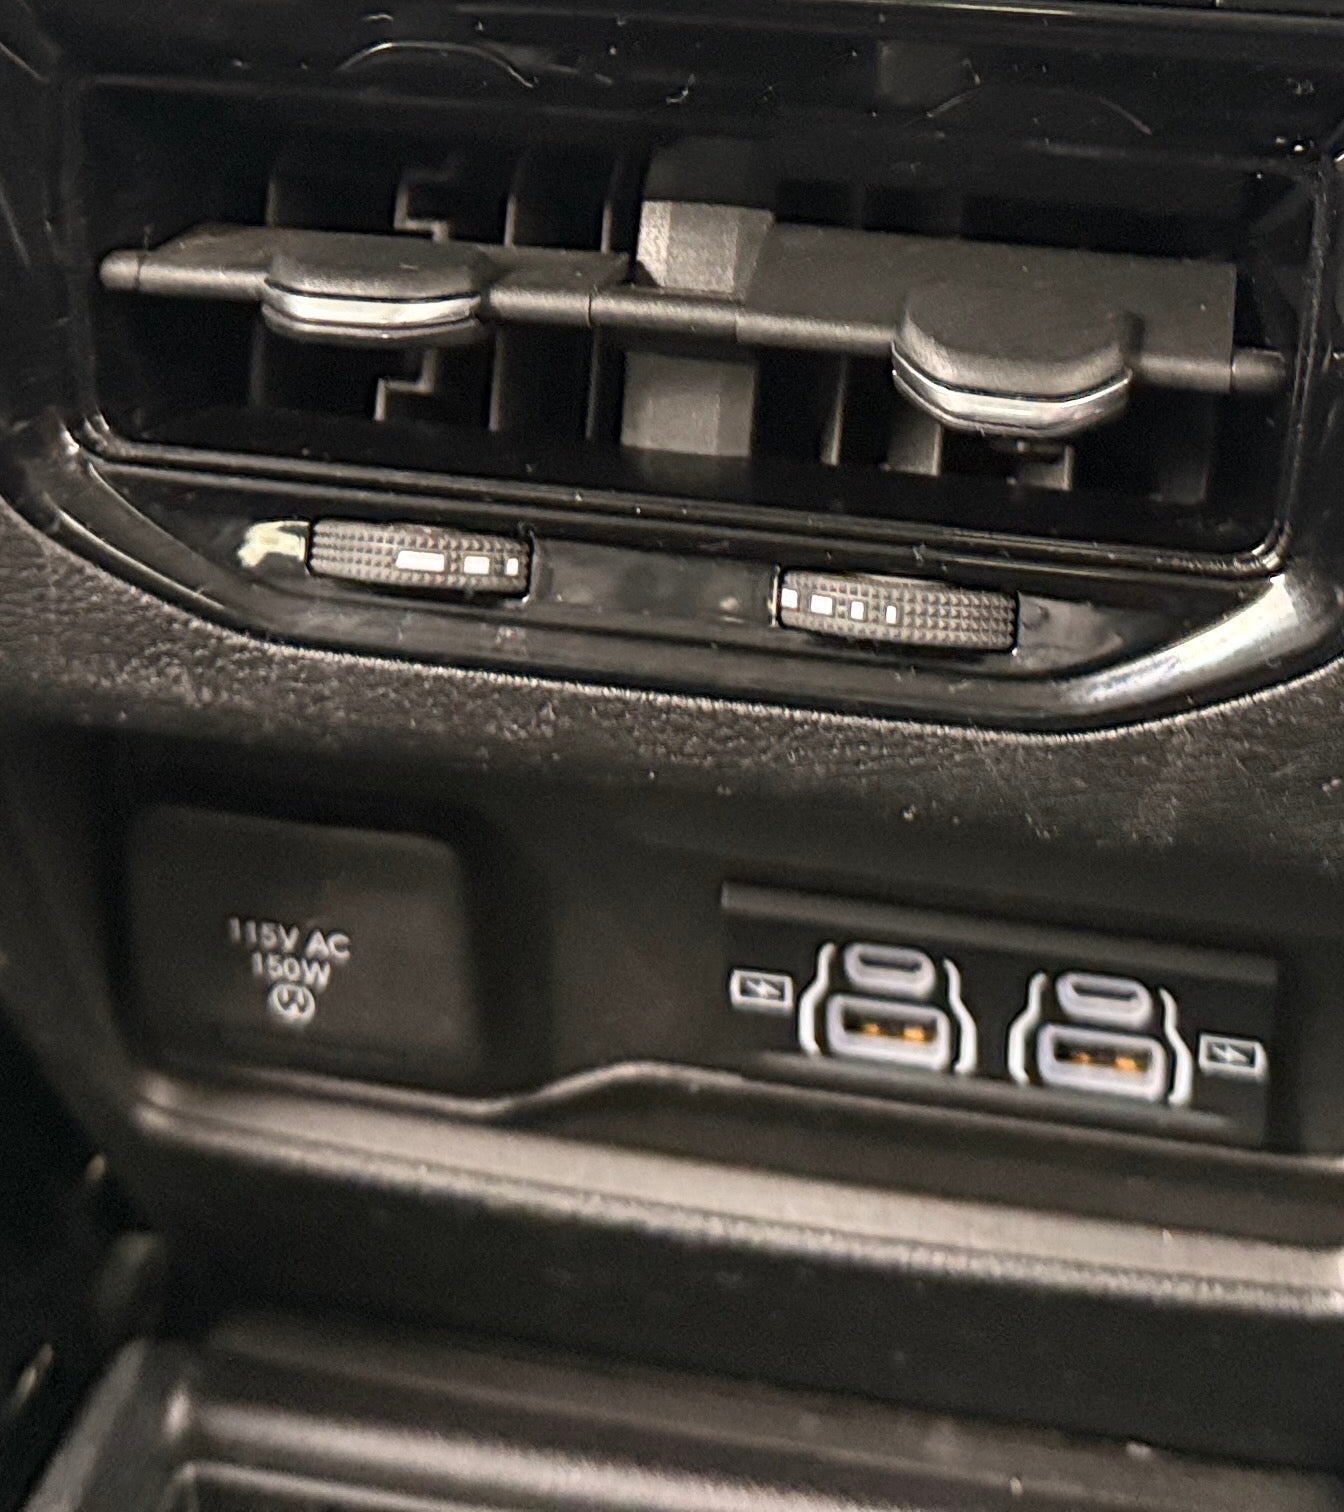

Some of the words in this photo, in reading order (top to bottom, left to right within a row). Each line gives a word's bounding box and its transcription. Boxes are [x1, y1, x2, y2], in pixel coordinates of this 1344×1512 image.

[229, 916, 300, 953] 115V
[305, 929, 351, 963] AC
[252, 951, 331, 989] 150W
